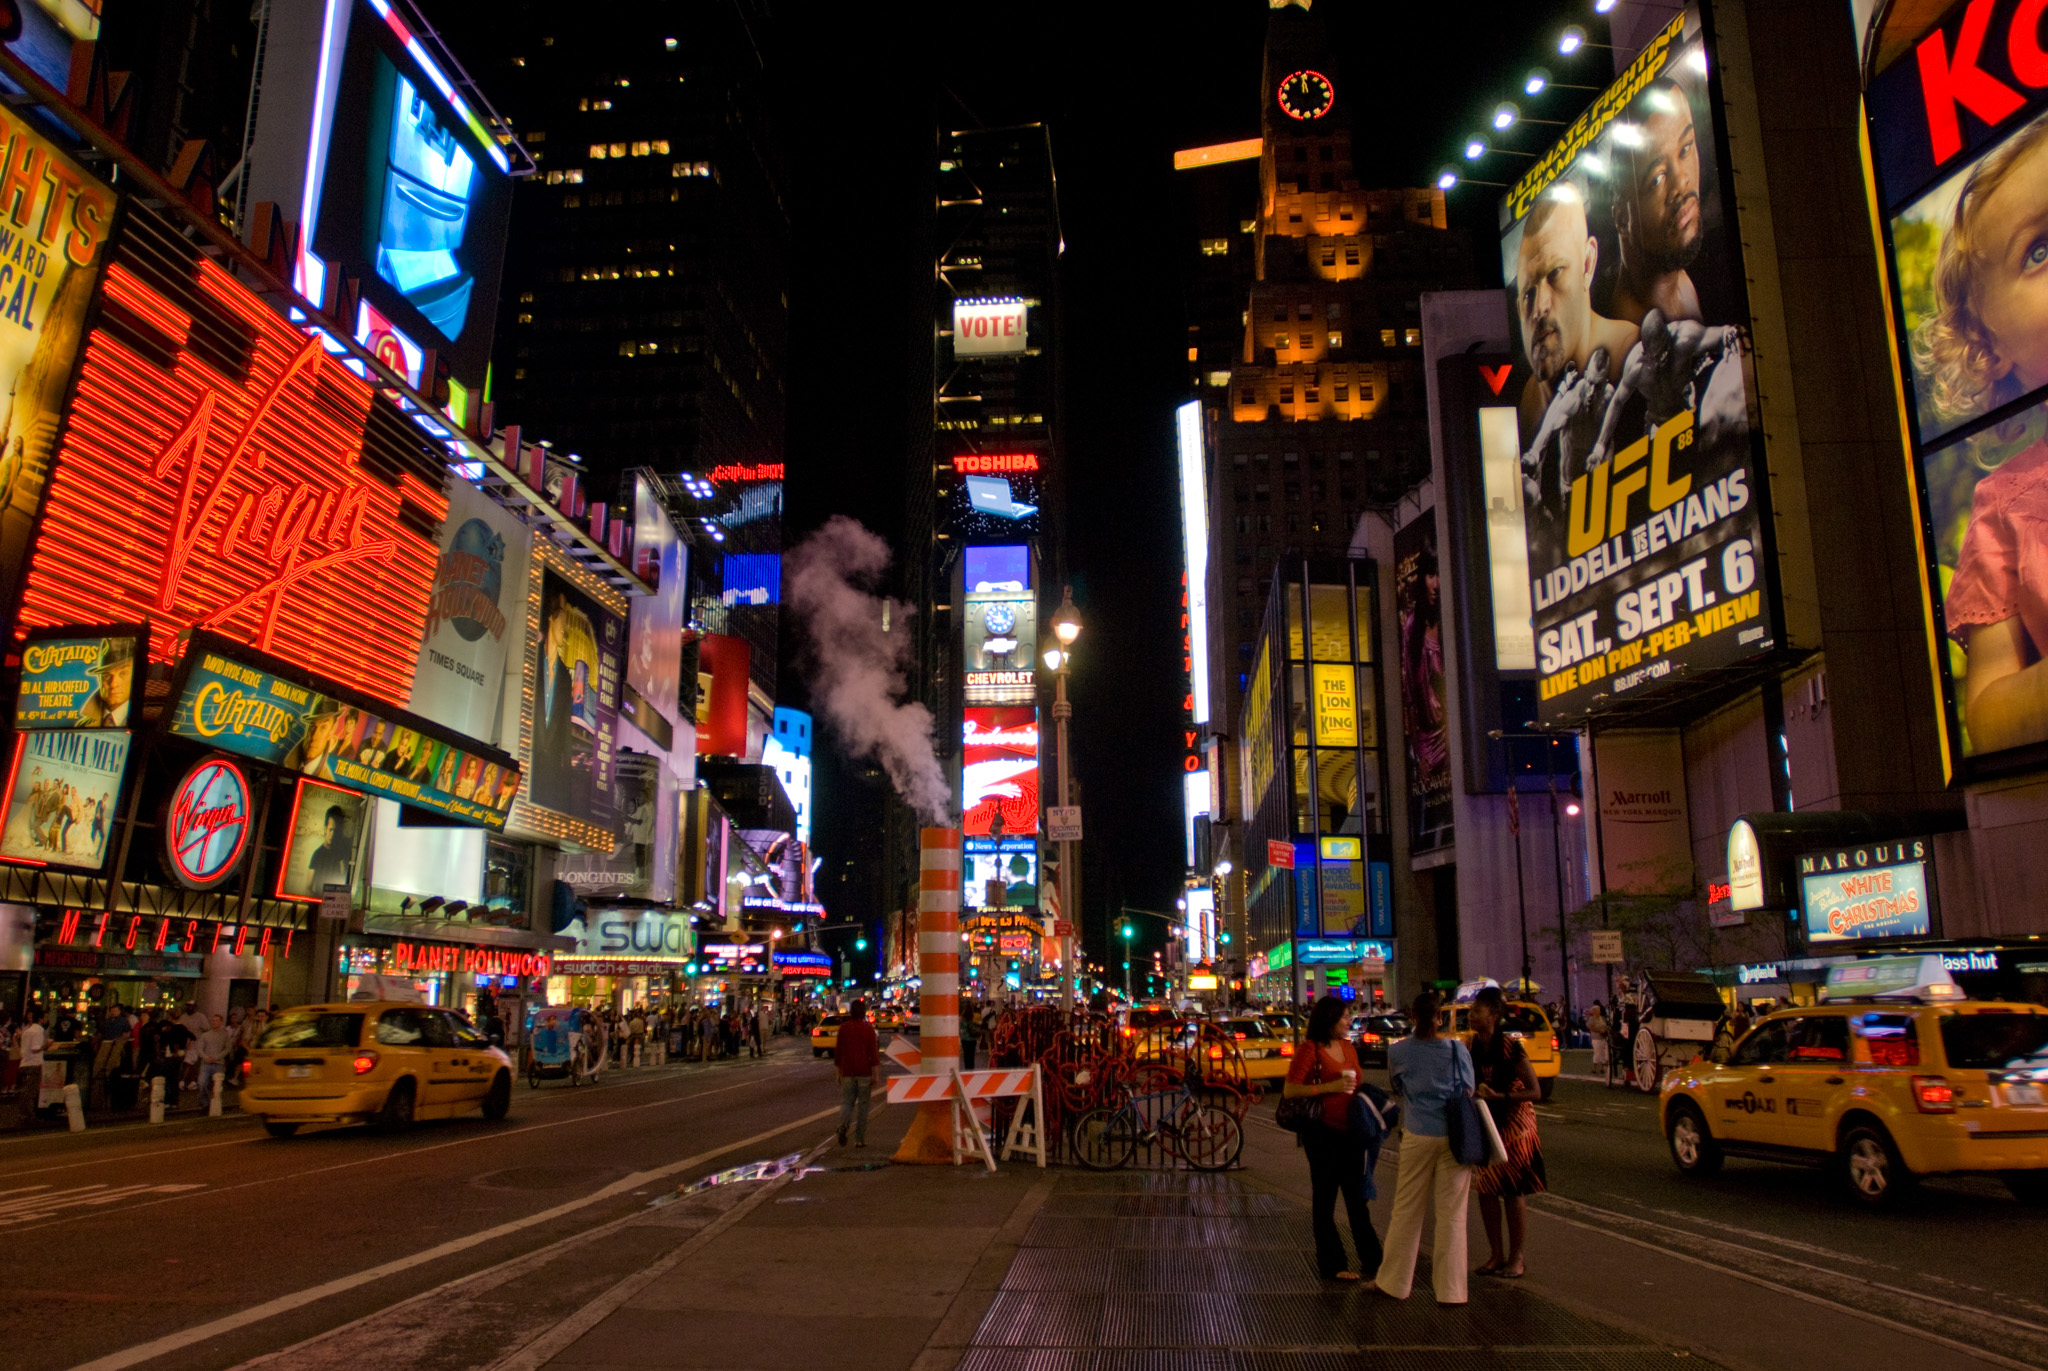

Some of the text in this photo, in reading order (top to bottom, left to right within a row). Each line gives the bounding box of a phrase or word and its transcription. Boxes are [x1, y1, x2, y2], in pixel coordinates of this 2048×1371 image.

[1507, 10, 1686, 208] ULTIMATE FIGHTING
[1514, 49, 1669, 222] CHAMPIONSHIP
[0, 112, 104, 267] HTS
[960, 315, 1022, 338] VOTE!
[954, 454, 1039, 472] TOSHIBA
[155, 334, 398, 655] Virgin
[1568, 410, 1695, 558] UFC 88
[1534, 535, 1632, 612] LIDDELL
[1649, 469, 1749, 554] EVANS
[1540, 539, 1755, 674] SAT., SEPT. 6
[1541, 668, 1577, 700] LIVE
[1580, 655, 1606, 684] ON
[1608, 591, 1760, 675] PAY-PER-VIEW
[202, 654, 225, 674] DAVID
[223, 661, 242, 681] HYDE
[239, 666, 262, 688] PIERCE
[270, 680, 290, 699] DEBRA
[429, 649, 485, 686] TIMES SQUARE
[966, 671, 1034, 685] CHEVROLET
[31, 680, 89, 694] AL HIRSCHFELD
[1323, 680, 1346, 691] THE
[39, 694, 73, 707] THEATRE
[1320, 694, 1351, 713] LION
[1320, 715, 1353, 735] KING
[29, 733, 124, 773] MAMMA MIA!
[334, 759, 347, 776] THE
[345, 762, 370, 783] MUSICAL
[369, 770, 393, 789] COMEDY
[1610, 790, 1671, 806] Marriott
[175, 766, 245, 873] Virgin
[1053, 809, 1076, 817] NYPD
[1646, 809, 1682, 817] MARQUIS
[975, 842, 992, 850] News
[1051, 831, 1080, 839] CAMERA
[1802, 841, 1925, 873] MARQUIS
[558, 871, 636, 885] LONGINES
[1841, 871, 1892, 899] WHITE
[744, 897, 762, 907] Live
[762, 898, 772, 907] on
[792, 904, 805, 912] are
[1828, 888, 1919, 935] CHRISTMAS
[58, 909, 294, 958] MEGASTORE
[396, 942, 551, 977] PLANET HOLLYWOOD
[564, 962, 615, 975] swatch
[1970, 952, 1998, 969] hut
